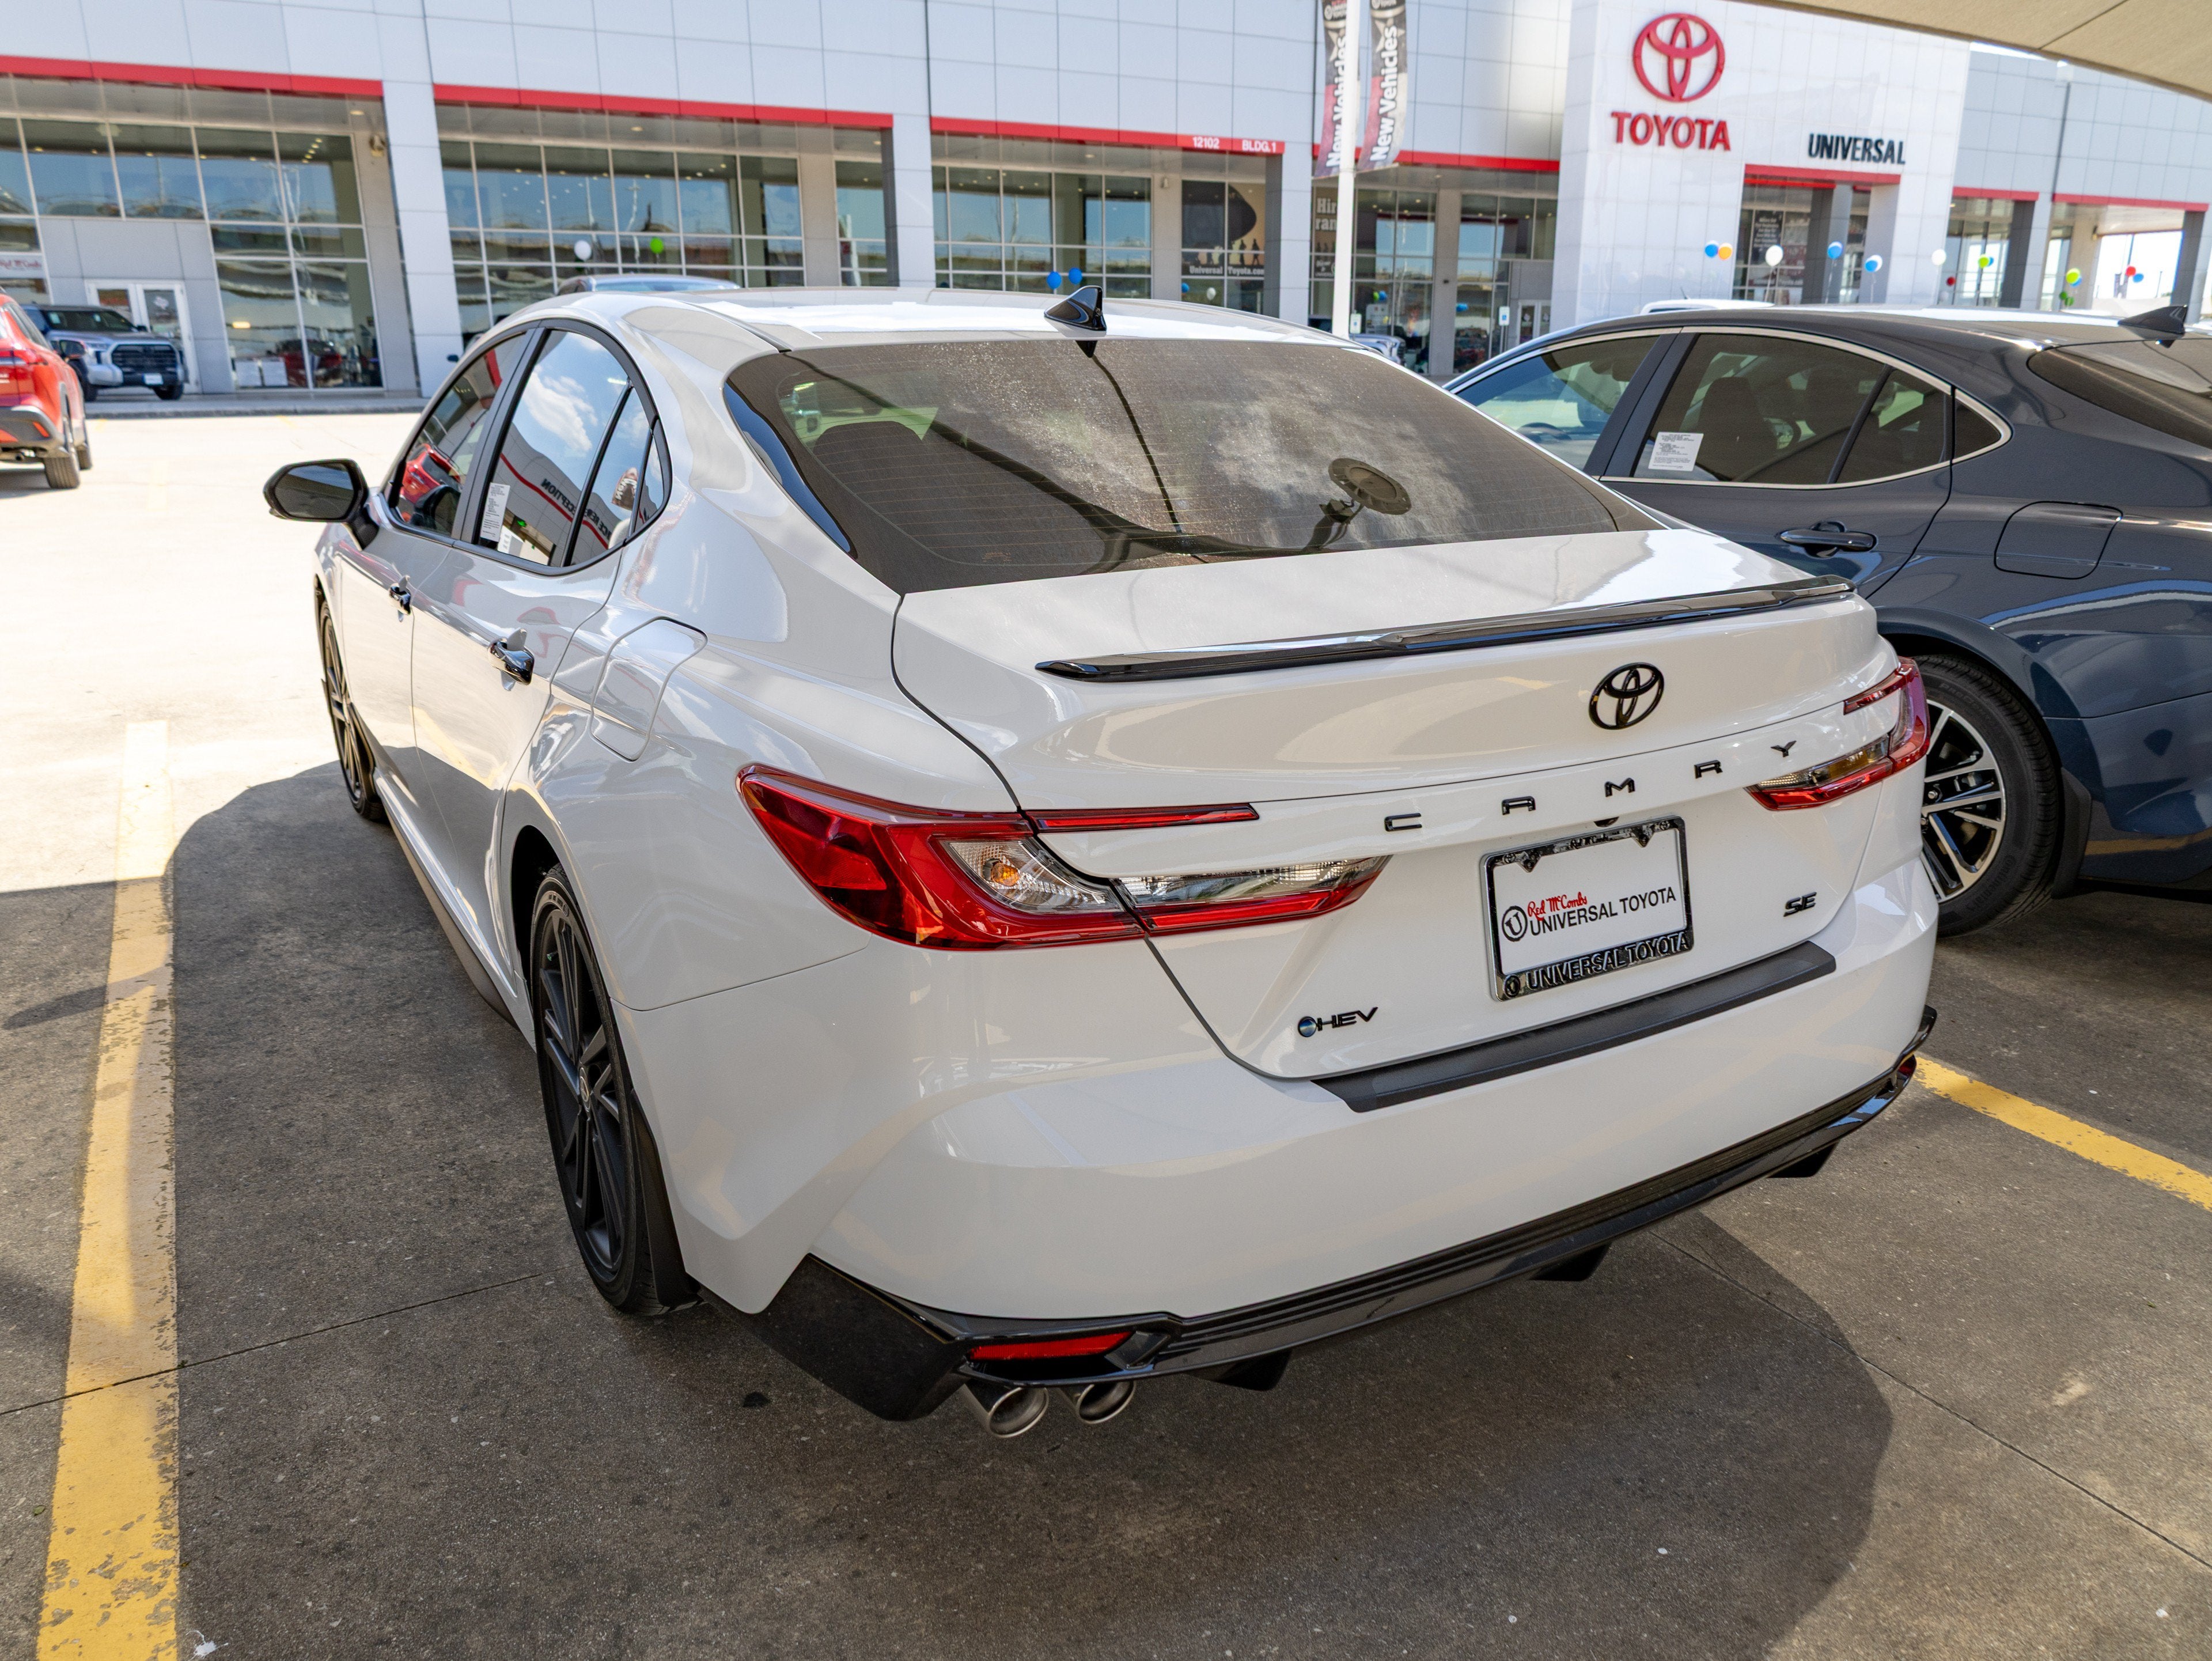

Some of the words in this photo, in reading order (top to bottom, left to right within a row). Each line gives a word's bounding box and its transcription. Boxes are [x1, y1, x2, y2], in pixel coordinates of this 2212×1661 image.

[1379, 25, 1398, 115] Vehicles
[1192, 136, 1220, 150] 12102
[1242, 139, 1270, 152] BLDG.
[1271, 142, 1277, 153] 1
[1370, 116, 1395, 161] New
[1611, 111, 1730, 151] TOYOTA
[1808, 133, 1906, 165] UNIVERSAL
[1317, 198, 1336, 214] Hir
[1190, 266, 1223, 274] Universal
[1385, 740, 1797, 831] CAMRY
[1527, 901, 1546, 921] Red
[1546, 891, 1588, 912] McCombs
[1529, 901, 1618, 936] UNIVERSAL
[1619, 887, 1677, 914] TOYOTA
[1783, 892, 1817, 917] SE
[1526, 949, 1626, 990] UNIVERSAL
[1624, 931, 1689, 964] TOYOTA
[1317, 1007, 1378, 1031] HEV
